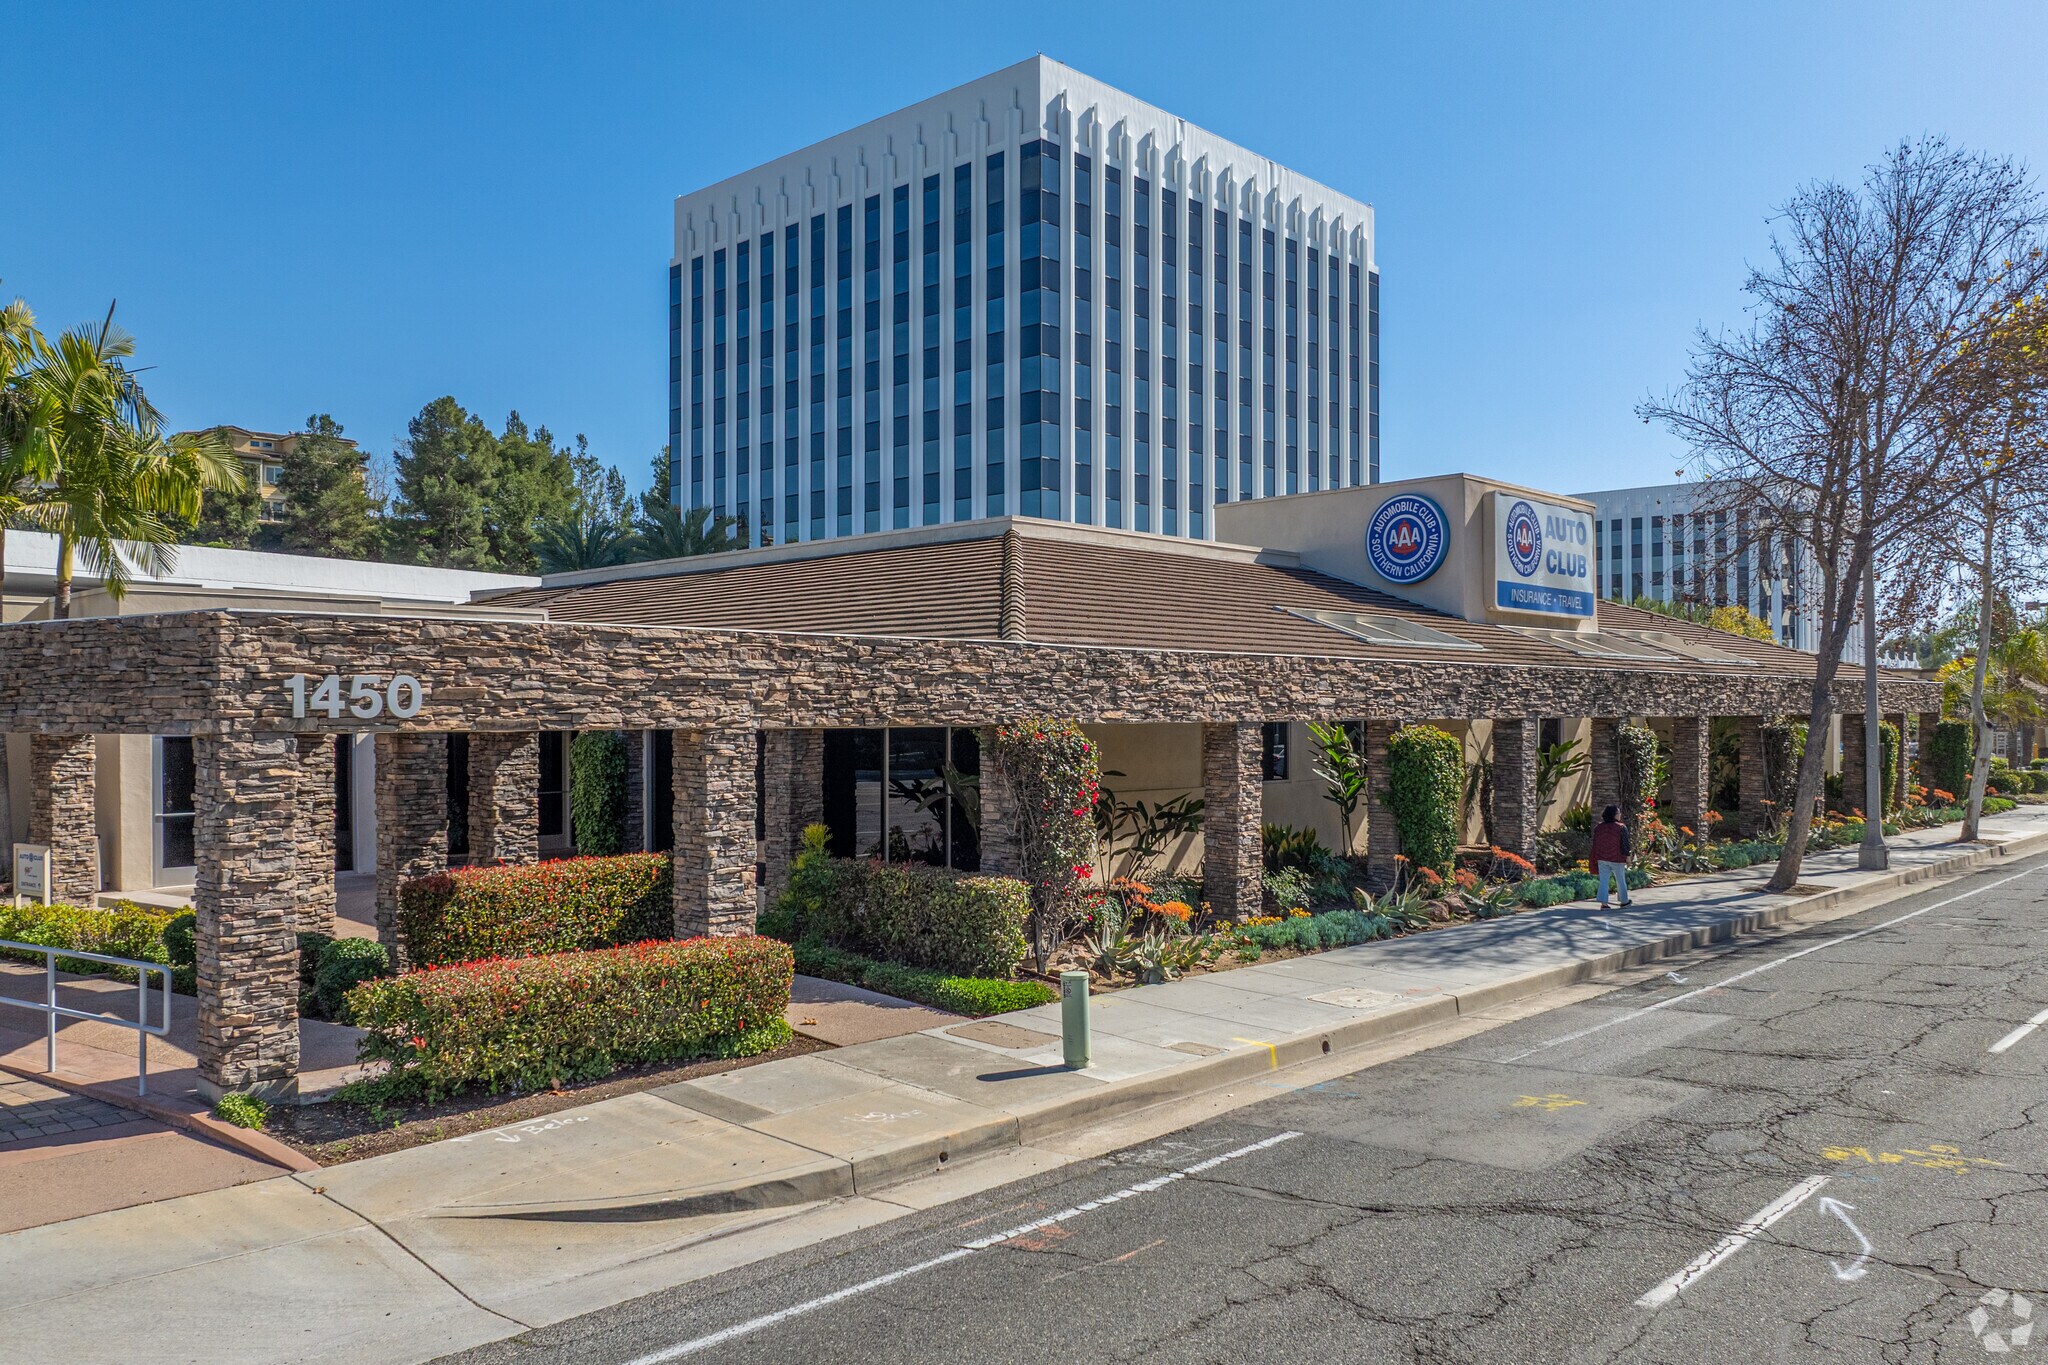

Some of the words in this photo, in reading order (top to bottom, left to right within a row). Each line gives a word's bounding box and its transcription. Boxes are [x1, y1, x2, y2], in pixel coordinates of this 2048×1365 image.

[1374, 501, 1419, 533] AUTOMOBILE
[1419, 507, 1437, 529] CLUB
[1508, 504, 1531, 530] AUTOMOBILE
[1530, 514, 1540, 535] CLUB
[1545, 515, 1587, 546] AUTO
[1389, 526, 1421, 547] AAA
[1516, 528, 1533, 547] AAA
[1371, 538, 1403, 576] SOUTHERN
[1404, 533, 1439, 576] CALIFORNIA
[1507, 533, 1524, 574] SOUTHERN
[1524, 540, 1541, 574] CALIFORNIA
[1546, 549, 1587, 578] CLUB
[1511, 588, 1552, 606] INSURANCE
[1558, 594, 1583, 610] TRAVEL
[283, 673, 423, 719] 1450
